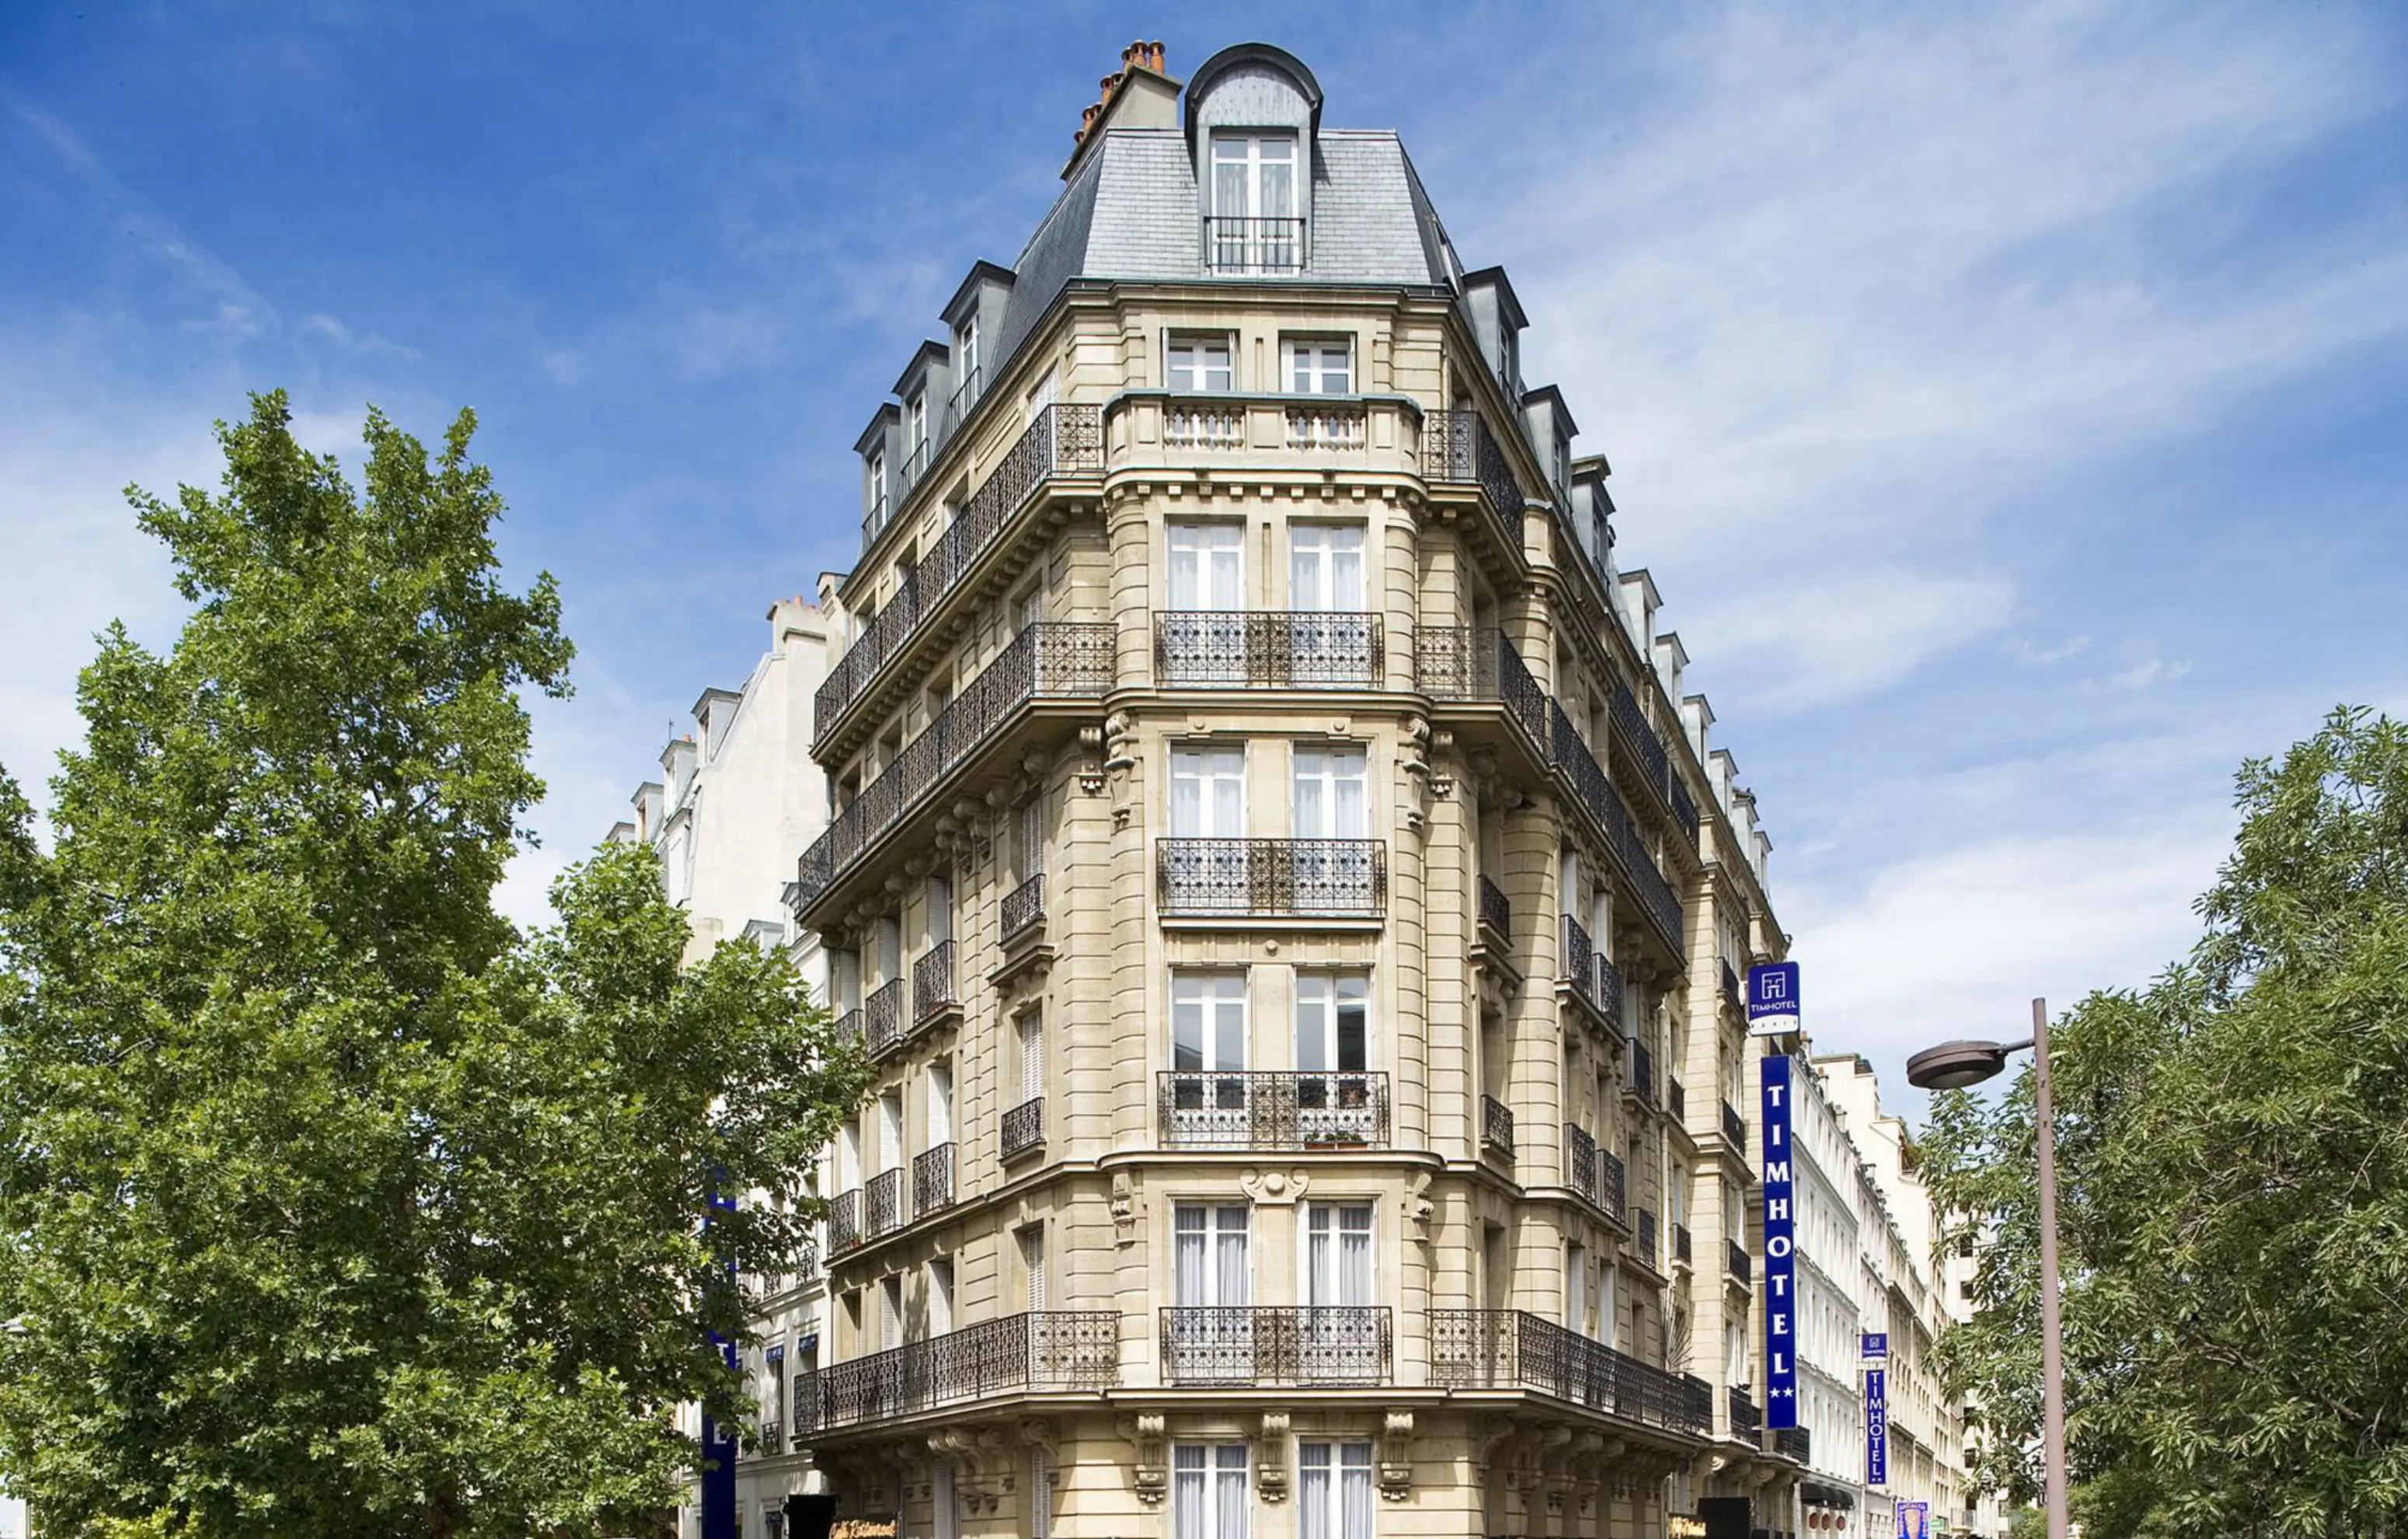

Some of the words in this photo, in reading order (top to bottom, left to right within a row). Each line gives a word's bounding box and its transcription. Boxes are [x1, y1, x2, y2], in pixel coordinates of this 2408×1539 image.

[1751, 1000, 1797, 1012] TIMHOTEL
[1766, 1085, 1792, 1374] TIMHOTEL
[1869, 1372, 1884, 1475] TIMHOTEL
